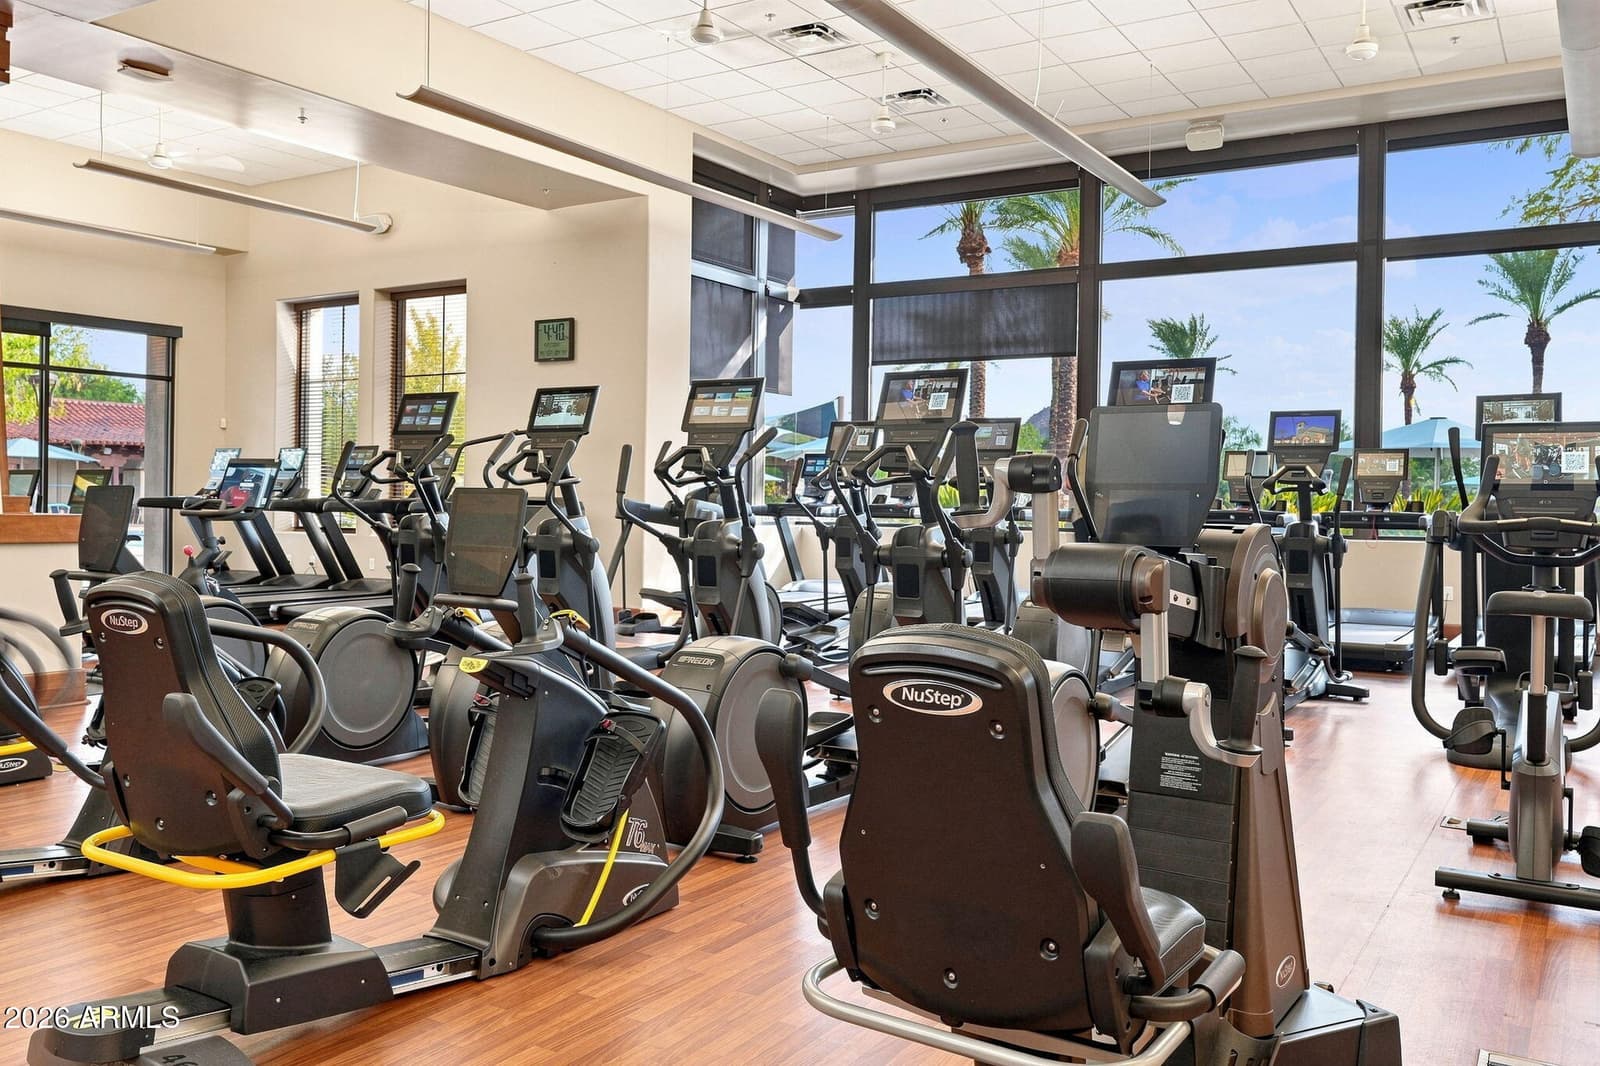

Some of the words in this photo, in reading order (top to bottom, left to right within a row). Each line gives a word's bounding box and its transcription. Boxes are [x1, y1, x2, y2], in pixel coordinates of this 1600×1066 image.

[109, 615, 139, 629] NuStep
[901, 686, 963, 709] NuStep
[625, 816, 648, 849] T6
